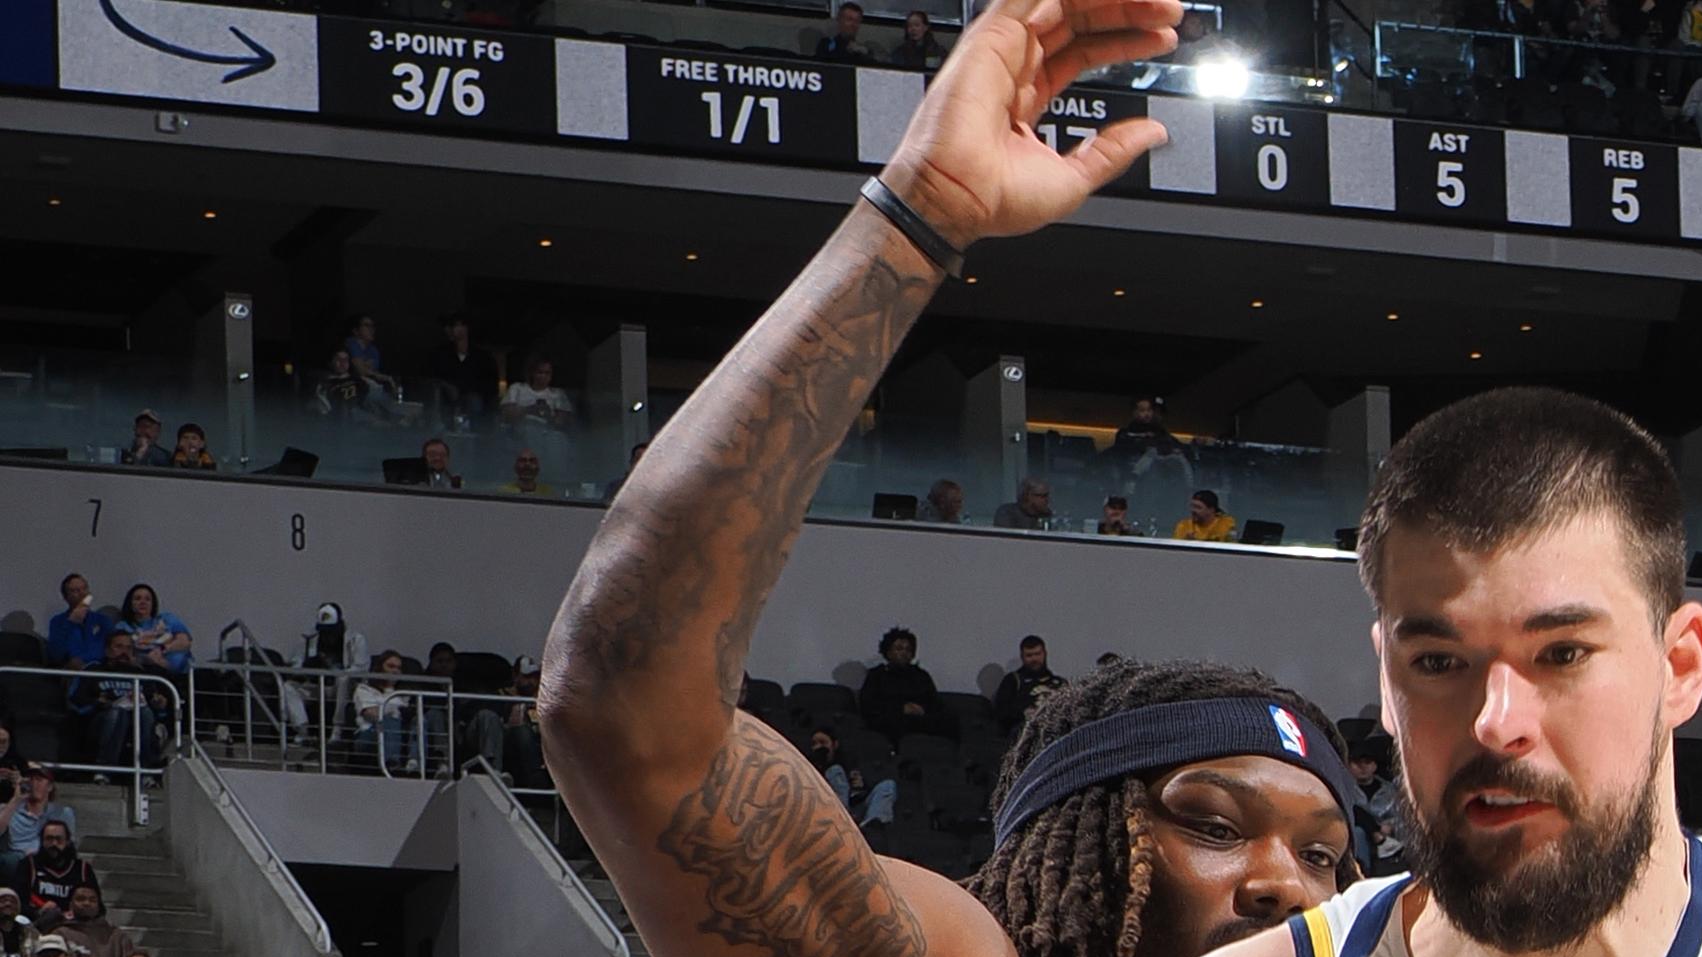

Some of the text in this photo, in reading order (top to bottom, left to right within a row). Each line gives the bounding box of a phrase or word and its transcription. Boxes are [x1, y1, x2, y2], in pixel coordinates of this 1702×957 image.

[369, 30, 504, 62] 3-POINT FG
[392, 62, 485, 117] 3/6
[660, 57, 823, 92] FREE THROWS
[701, 91, 780, 144] 1/1
[1251, 114, 1291, 136] STL
[1428, 131, 1470, 153] AST
[1602, 148, 1645, 170] REB
[1257, 143, 1288, 191] 0
[1436, 160, 1467, 207] 5
[1611, 177, 1640, 223] 5
[88, 498, 102, 538] 7
[291, 512, 305, 551] 8
[38, 880, 72, 899] PORTL
